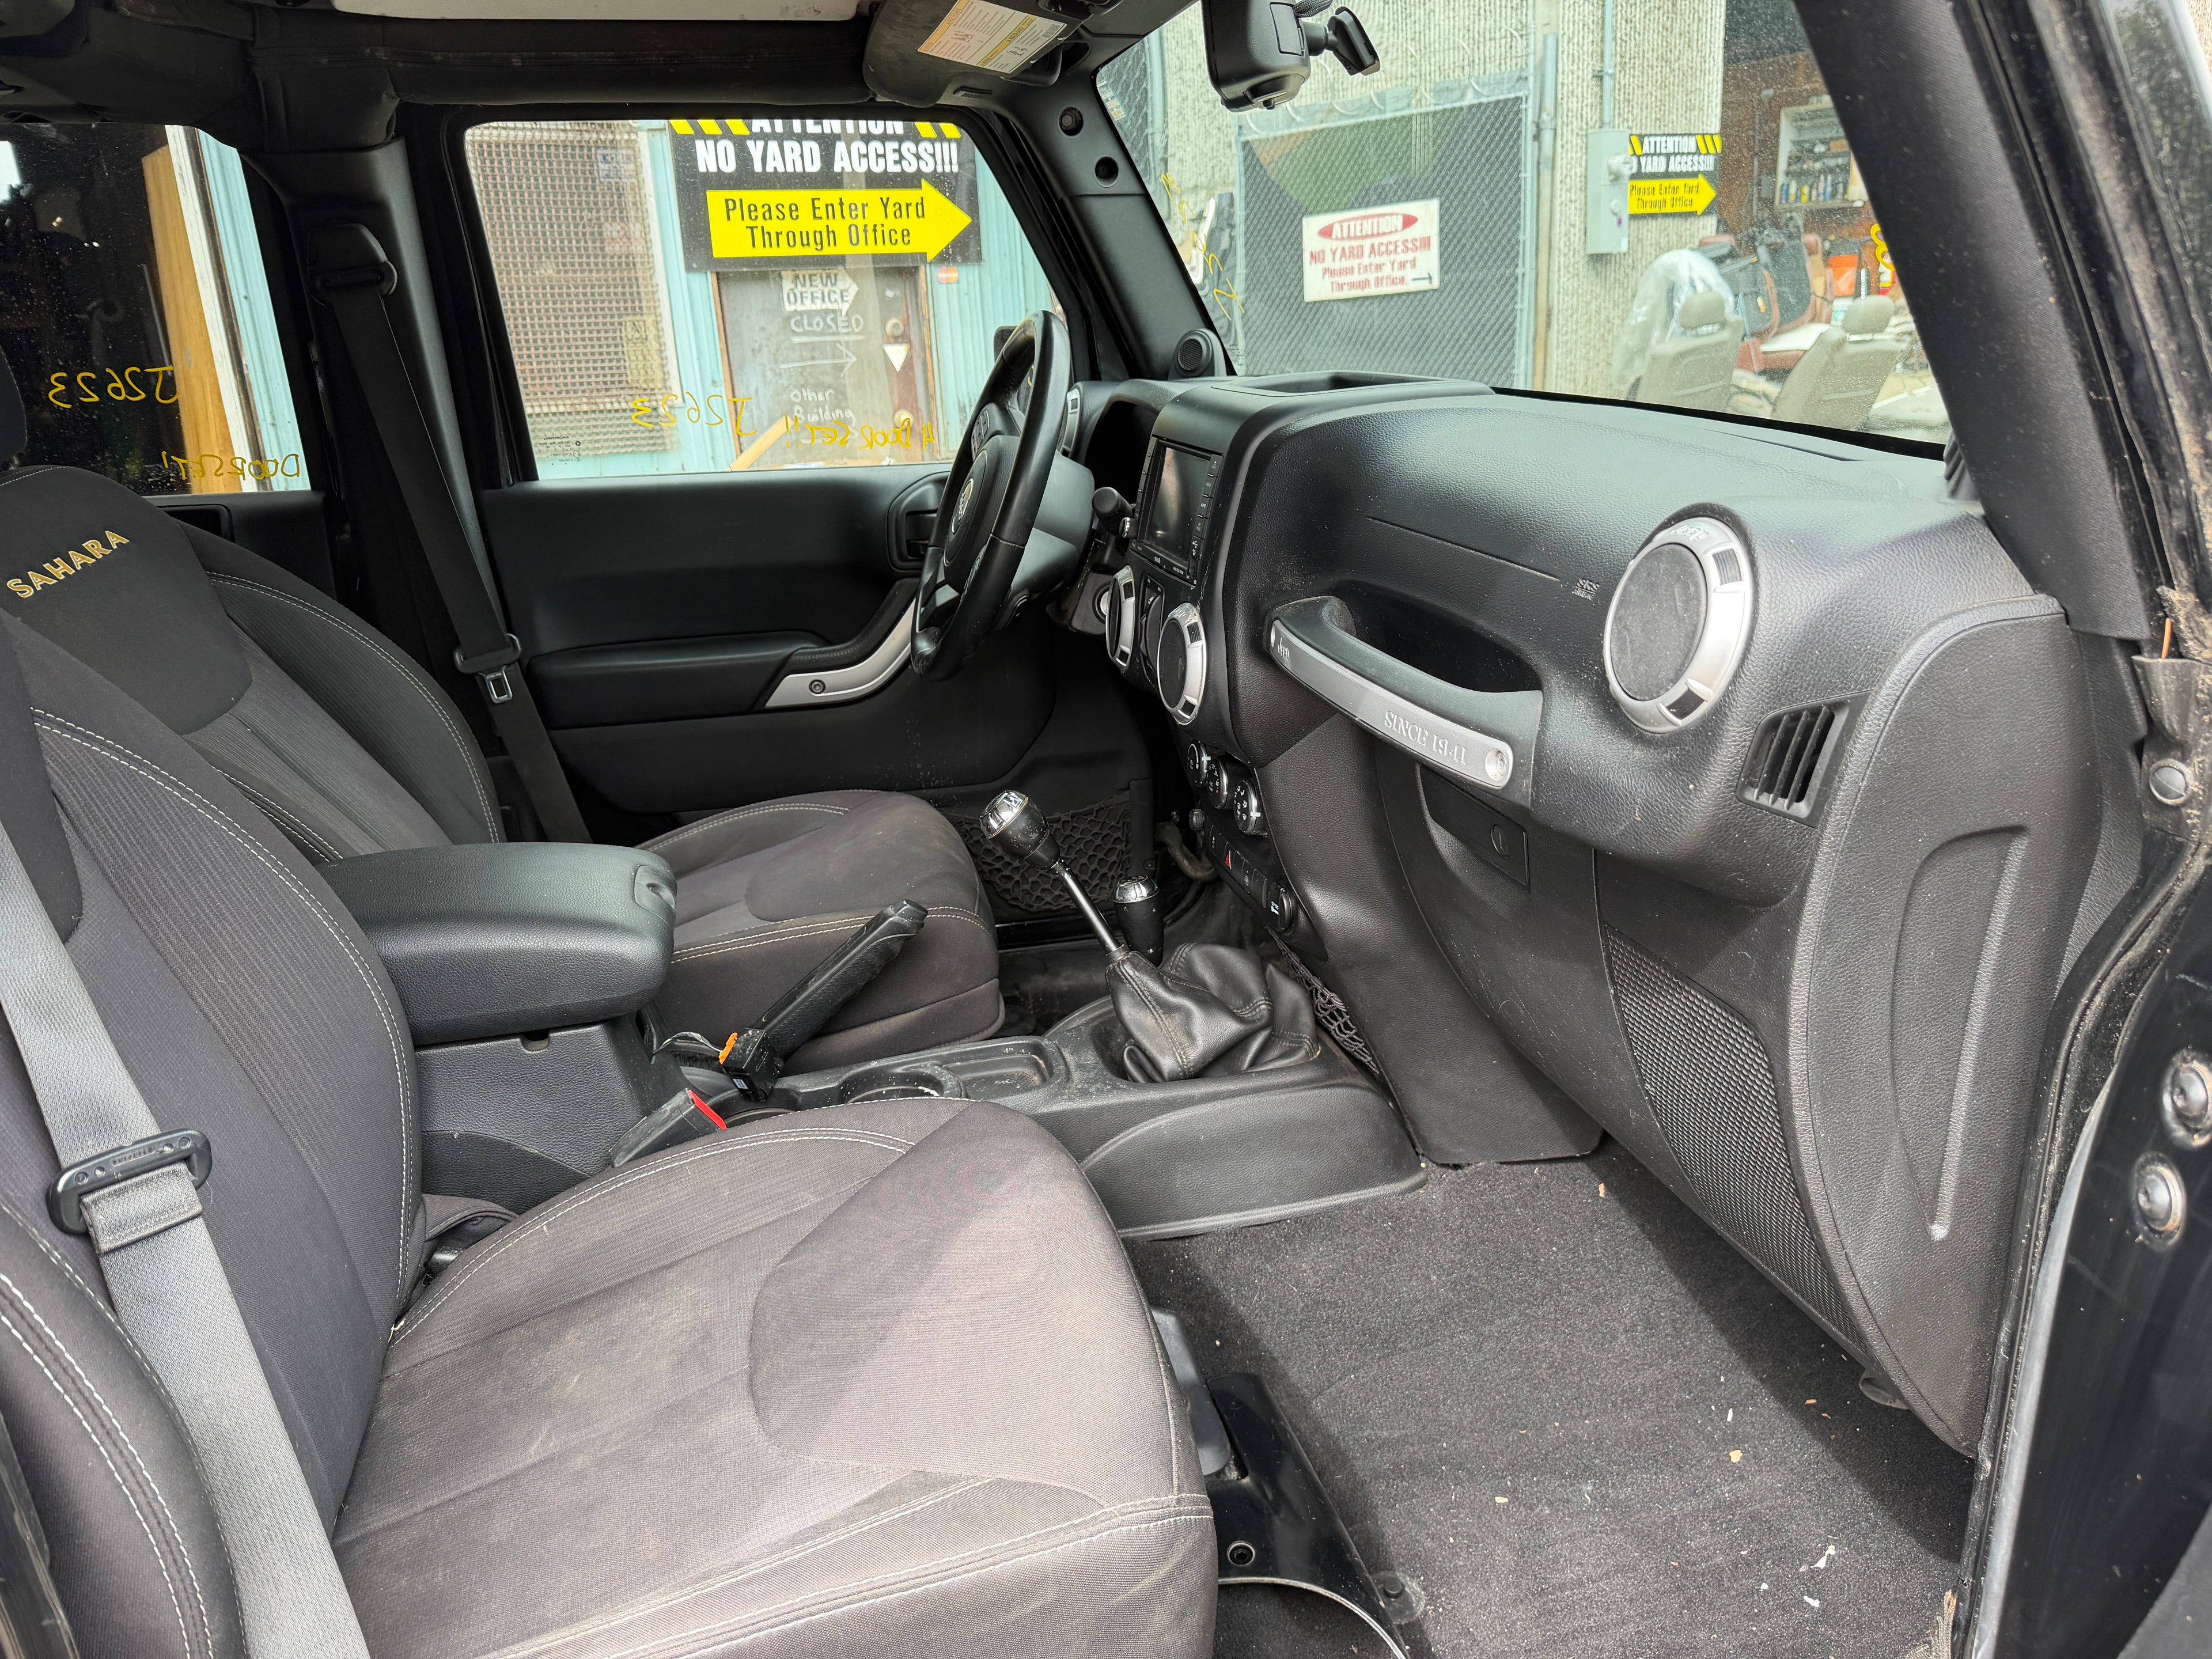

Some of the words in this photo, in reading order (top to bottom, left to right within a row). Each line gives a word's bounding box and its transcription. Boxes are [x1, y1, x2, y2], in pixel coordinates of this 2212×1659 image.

[1642, 134, 1696, 154] ATTENTION
[695, 139, 736, 173] NO
[746, 139, 821, 173] YARD
[834, 140, 959, 173] ACCESS!!!
[1639, 155, 1667, 173] YARD
[1630, 183, 1655, 196] Please
[1658, 183, 1680, 195] Enter
[1683, 181, 1699, 194] Yard
[724, 197, 800, 222] Please
[811, 197, 869, 221] Enter
[879, 196, 926, 219] Yard
[1636, 196, 1666, 210] Through
[1670, 195, 1694, 208] Office
[745, 224, 838, 252] Through
[848, 223, 912, 247] Office
[1331, 214, 1403, 240] ATTENTION
[1309, 248, 1325, 266] NO
[1330, 244, 1364, 261] YARD
[1321, 264, 1355, 279] Please
[1357, 261, 1386, 275] Enter
[1389, 256, 1417, 271] Yard
[794, 272, 838, 289] NEW
[1330, 277, 1371, 293] Through
[787, 289, 849, 305] OFFICE
[790, 313, 864, 333] CLOSED
[789, 387, 835, 403] Other
[794, 404, 857, 427] Building
[6, 529, 131, 599] SAHARA
[1384, 710, 1429, 747] SINCE
[1432, 733, 1467, 766] 1941
